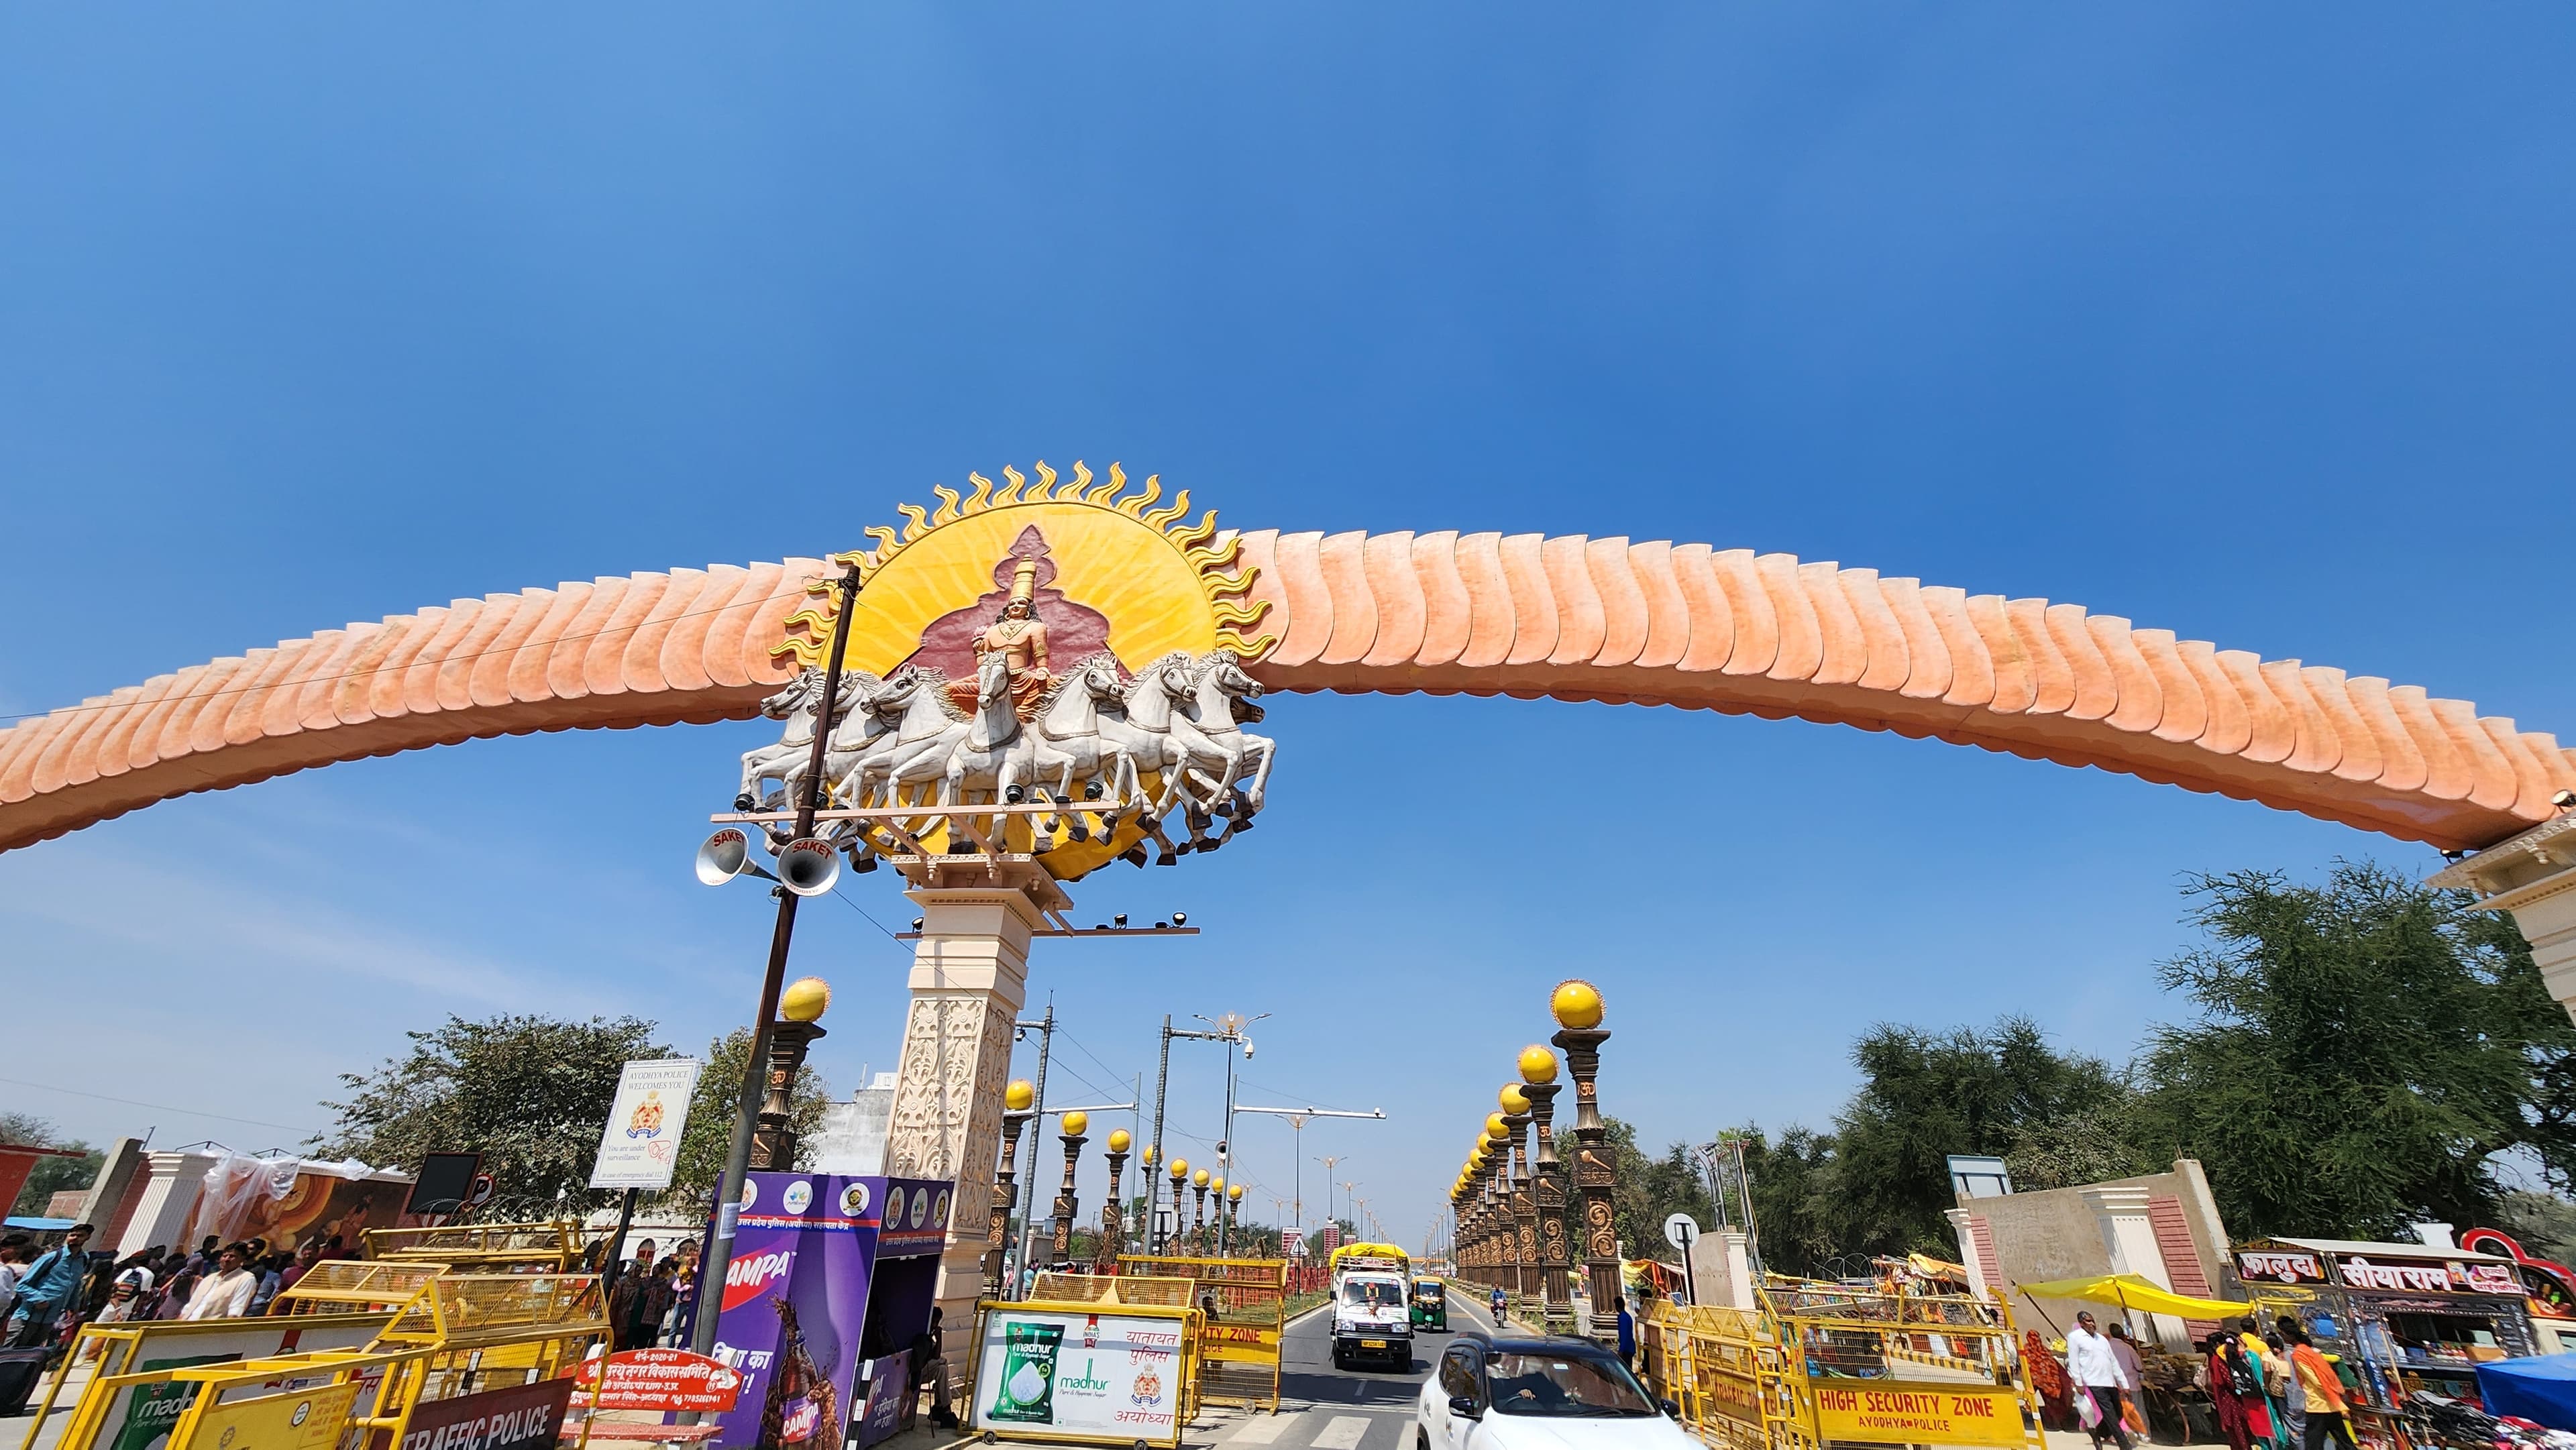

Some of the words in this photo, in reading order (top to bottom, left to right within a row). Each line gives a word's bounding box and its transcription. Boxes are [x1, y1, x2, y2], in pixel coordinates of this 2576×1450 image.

[793, 840, 833, 859] SAKET
[629, 1071, 663, 1080] AYODHYA
[663, 1070, 688, 1078] POLICE
[607, 1153, 641, 1161] surveillance
[737, 1217, 751, 1227] उत्तर
[751, 1217, 767, 1227] प्रदेश
[767, 1217, 786, 1229] पुलिस
[814, 1221, 838, 1230] सहायता
[726, 1251, 790, 1287] AMPA
[2239, 1253, 2319, 1284] फालुदा
[1012, 1330, 1054, 1354] madhur
[1229, 1328, 1262, 1343] ZONE
[1129, 1345, 1171, 1365] पुलिस
[1203, 1344, 1224, 1353] LICE
[748, 1350, 773, 1370] का
[1060, 1357, 1109, 1390] madhur
[137, 1380, 195, 1418] madh
[1715, 1382, 1746, 1408] TRAFFIC
[1747, 1392, 1777, 1416] POCE
[1819, 1390, 1858, 1411] HIGH
[1865, 1391, 1940, 1414] SECURITY
[1951, 1396, 1994, 1417] ZONE
[784, 1402, 818, 1437] CAMPA
[1114, 1408, 1175, 1425] अयोध्या
[402, 1416, 486, 1450] TRAFFIC
[484, 1404, 551, 1450] POLICE
[796, 1429, 808, 1437] COLA
